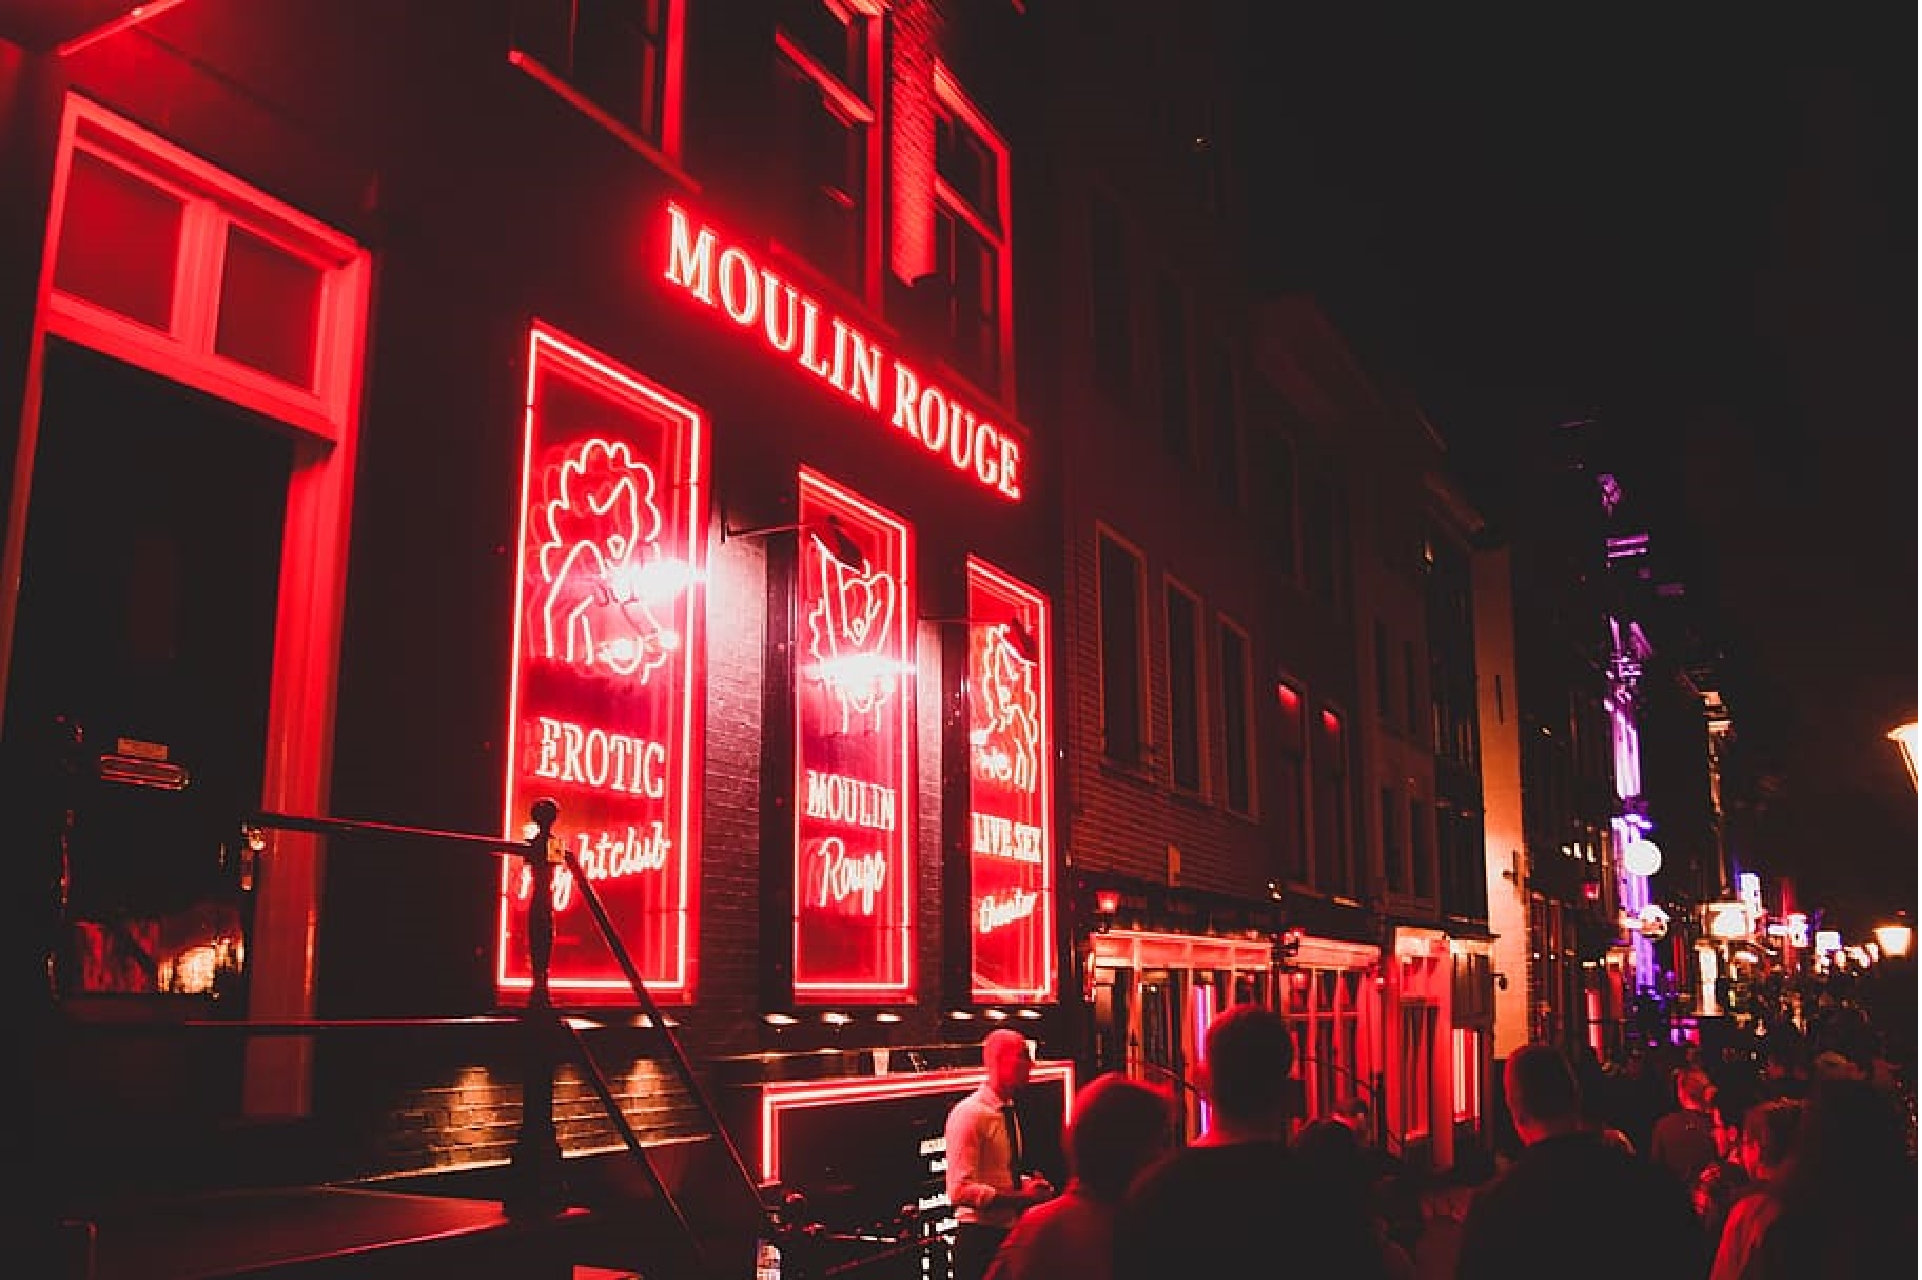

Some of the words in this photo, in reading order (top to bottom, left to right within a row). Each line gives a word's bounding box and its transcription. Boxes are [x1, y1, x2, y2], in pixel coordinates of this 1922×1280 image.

[664, 201, 884, 411] MOULIN
[891, 360, 1021, 499] ROUGE
[535, 716, 665, 798] EROTIC
[806, 769, 896, 831] MOULIN
[517, 819, 672, 912] ghtclub
